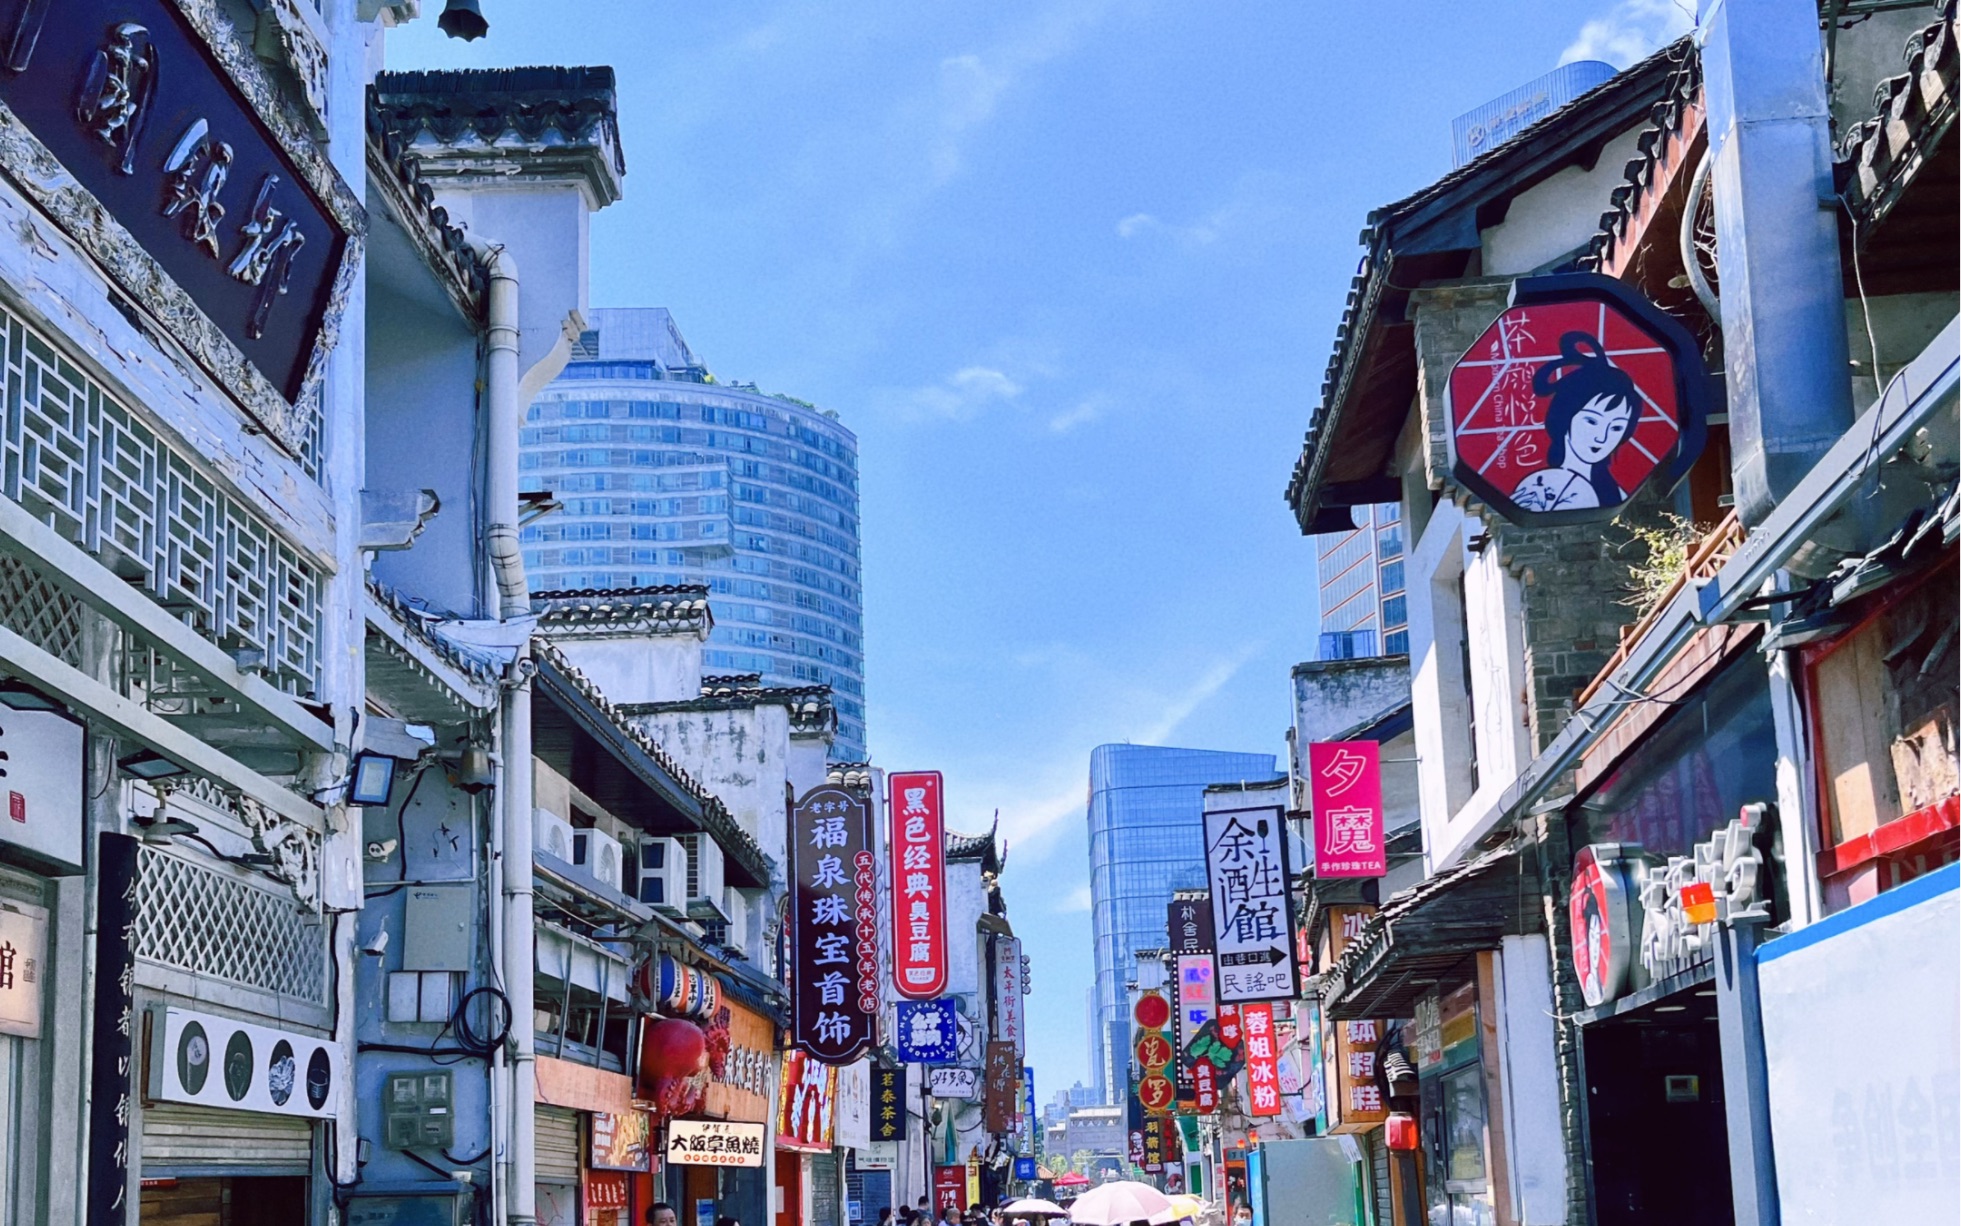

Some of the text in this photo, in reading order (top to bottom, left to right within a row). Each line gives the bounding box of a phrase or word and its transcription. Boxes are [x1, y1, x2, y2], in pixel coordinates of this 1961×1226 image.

[1493, 394, 1504, 422] China
[809, 801, 849, 813] 老字号
[1321, 749, 1375, 855] 夕魔
[810, 816, 852, 1045] 福泉珠宝首饰
[857, 854, 877, 1010] 五代传承十五年老店
[945, 1051, 956, 1059] 2F
[1245, 1011, 1277, 1109] 蓉姐冰粉
[879, 1072, 897, 1137] 茗泰茶舍
[1196, 1064, 1213, 1107] 臭豆腐
[670, 1134, 760, 1155] 大阪章魚燒
